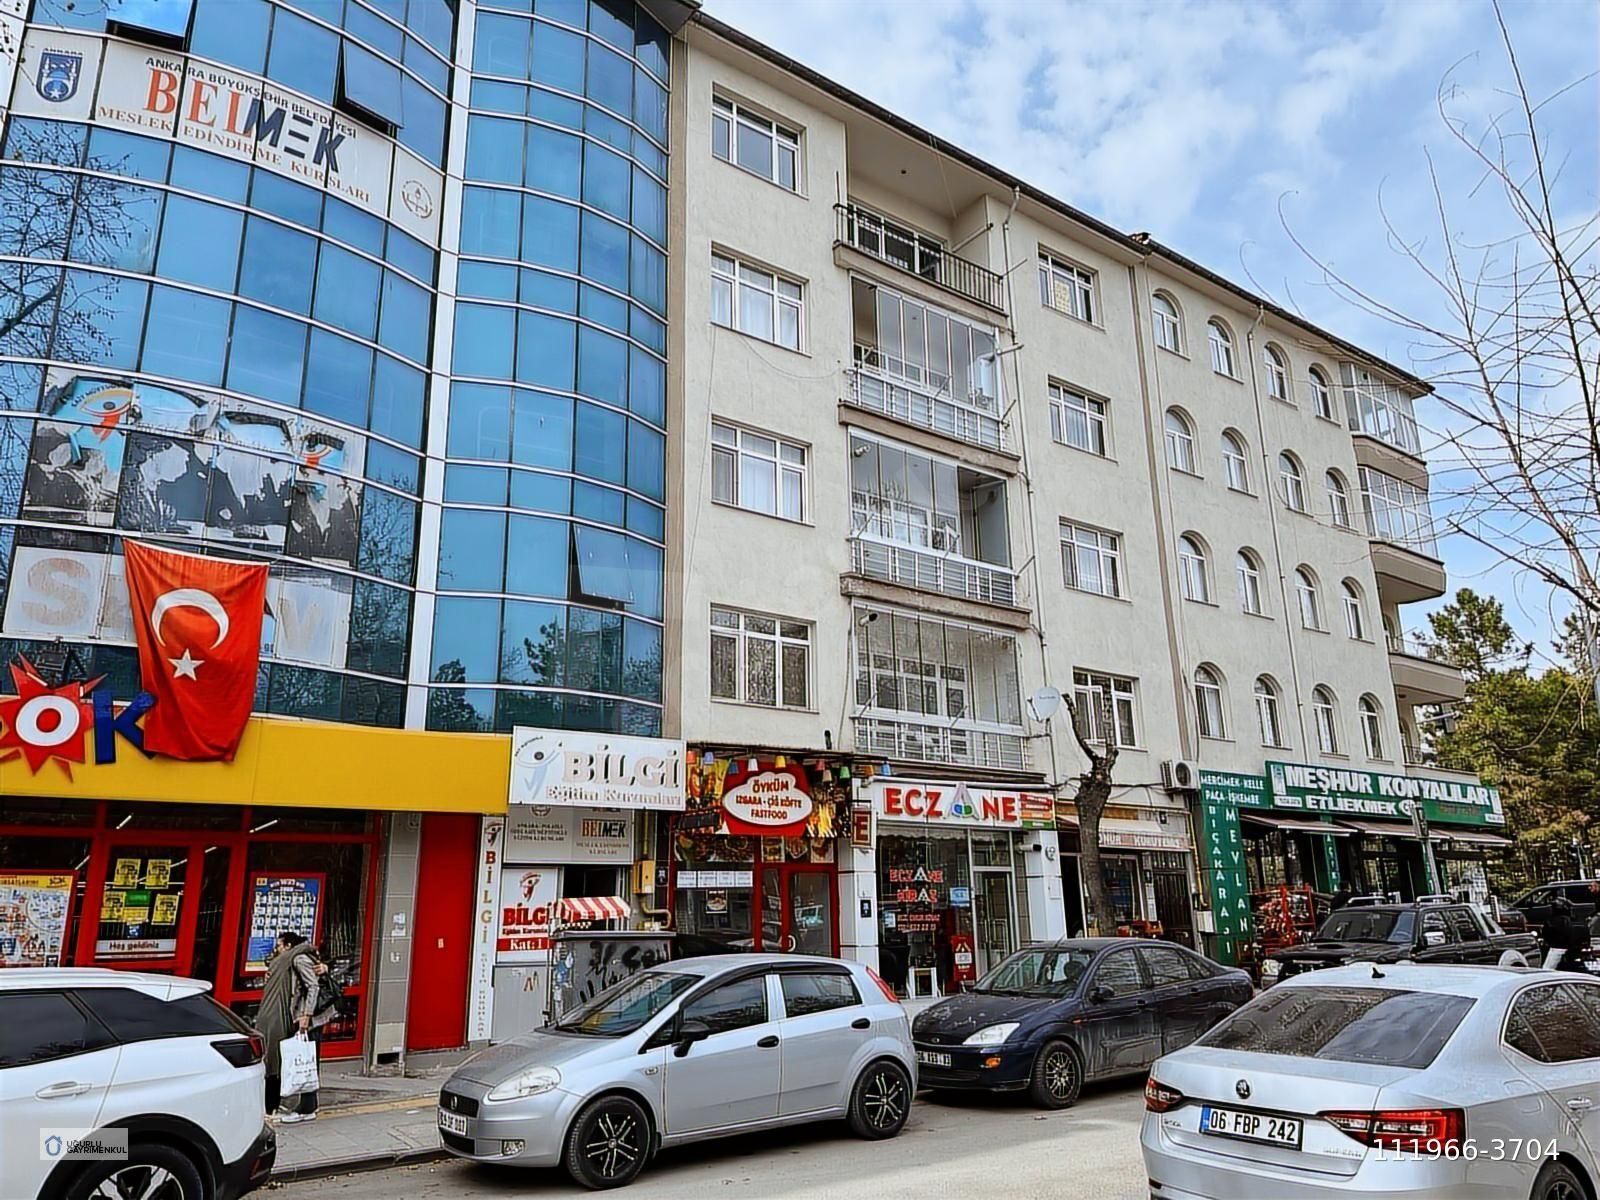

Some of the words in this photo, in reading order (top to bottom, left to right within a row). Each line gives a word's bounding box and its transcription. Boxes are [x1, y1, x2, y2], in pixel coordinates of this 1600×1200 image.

[146, 57, 205, 79] ANKARA
[143, 67, 345, 173] BELMEK
[100, 106, 172, 131] MESLEK
[184, 125, 281, 165] EDİNDİRME
[291, 160, 370, 202] KURSLARI
[0, 687, 155, 765] OK
[562, 744, 681, 789] BİLGİ
[547, 785, 599, 802] Eğitim
[752, 778, 789, 793] ÖYKÜM
[884, 782, 1018, 823] ECZANE
[1285, 765, 1374, 795] MEŞHUR
[1379, 776, 1490, 806] KONYALILAR
[751, 809, 788, 819] FASTFOOD
[1306, 793, 1397, 815] ETLİEKMEK
[582, 820, 626, 838] BELMEK
[481, 851, 496, 943] BİLGİ
[1211, 1110, 1226, 1129] 06
[1234, 1114, 1260, 1135] FBP
[1268, 1119, 1295, 1141] 242
